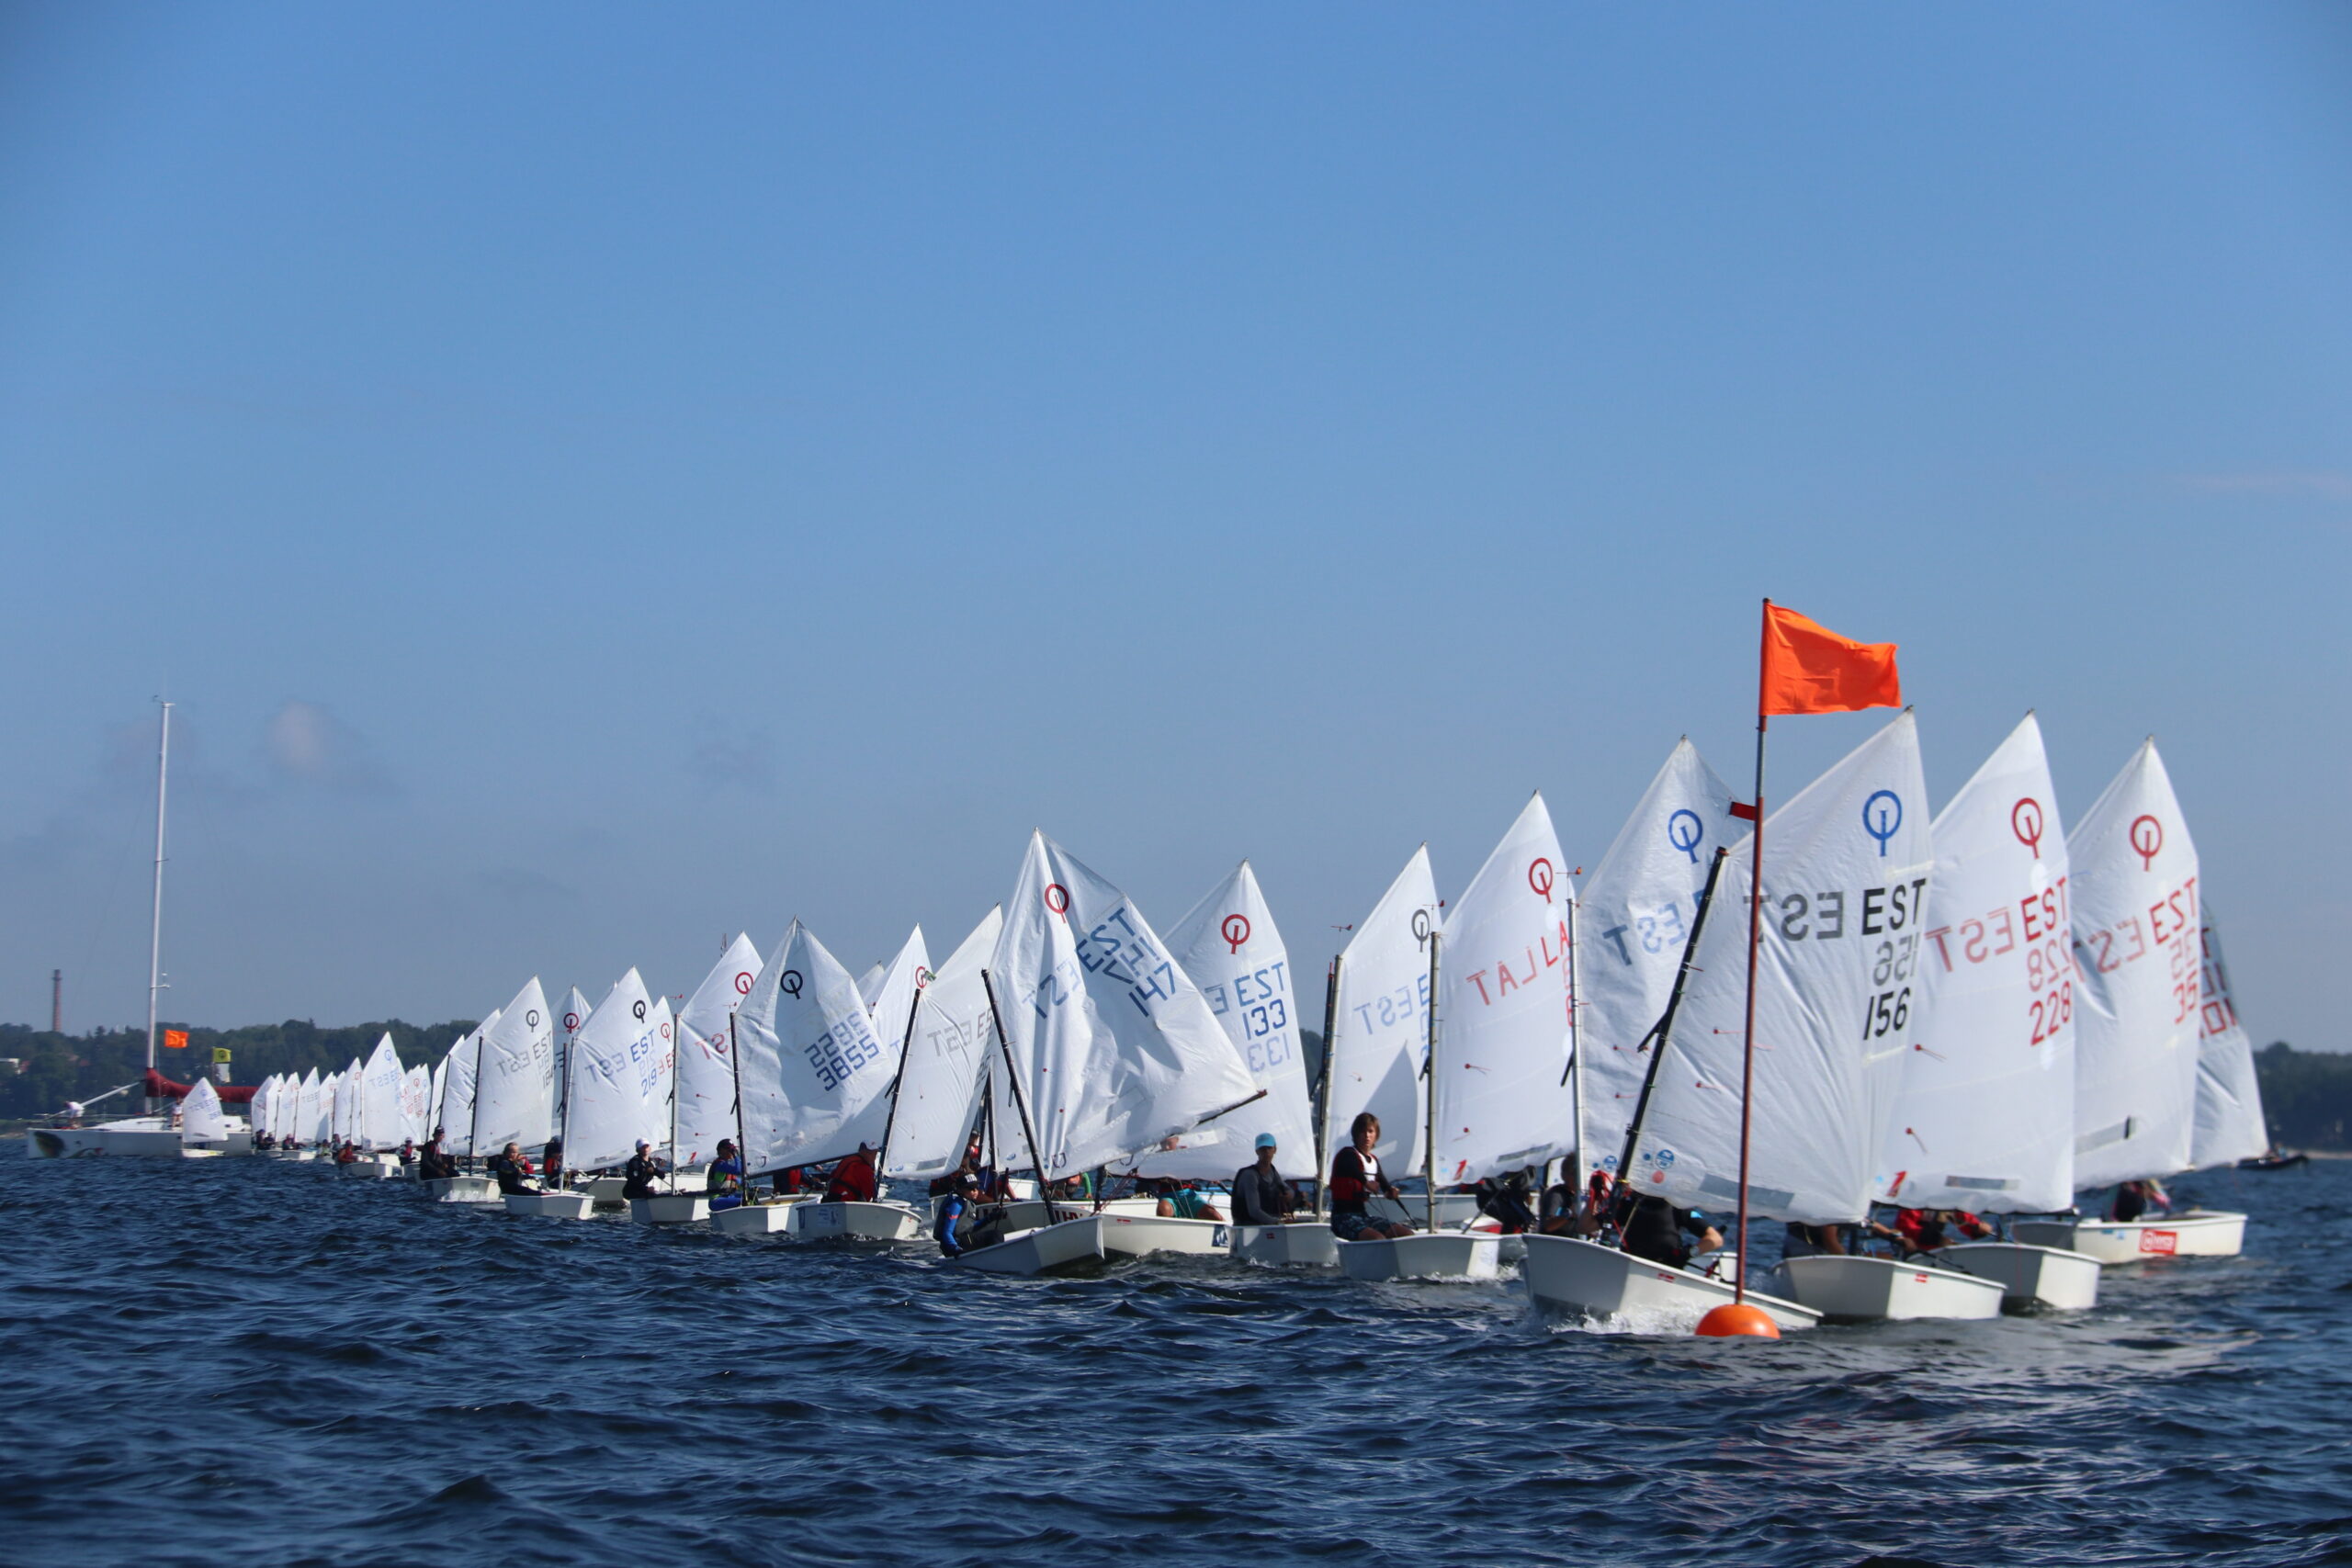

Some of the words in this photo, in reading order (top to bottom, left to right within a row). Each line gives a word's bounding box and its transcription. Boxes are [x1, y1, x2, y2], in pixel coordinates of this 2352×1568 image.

[1861, 877, 1927, 936] EST
[2020, 875, 2067, 943] EST
[2149, 876, 2197, 945] EST
[1075, 907, 1136, 973] EST
[1128, 960, 1177, 1018] 147
[1234, 961, 1285, 1007] EST
[2029, 979, 2071, 1047] 228
[1242, 998, 1287, 1041] 133
[1862, 987, 1911, 1041] 156
[629, 1028, 655, 1063] EST
[816, 1033, 880, 1092] 3855
[641, 1067, 657, 1098] 219
